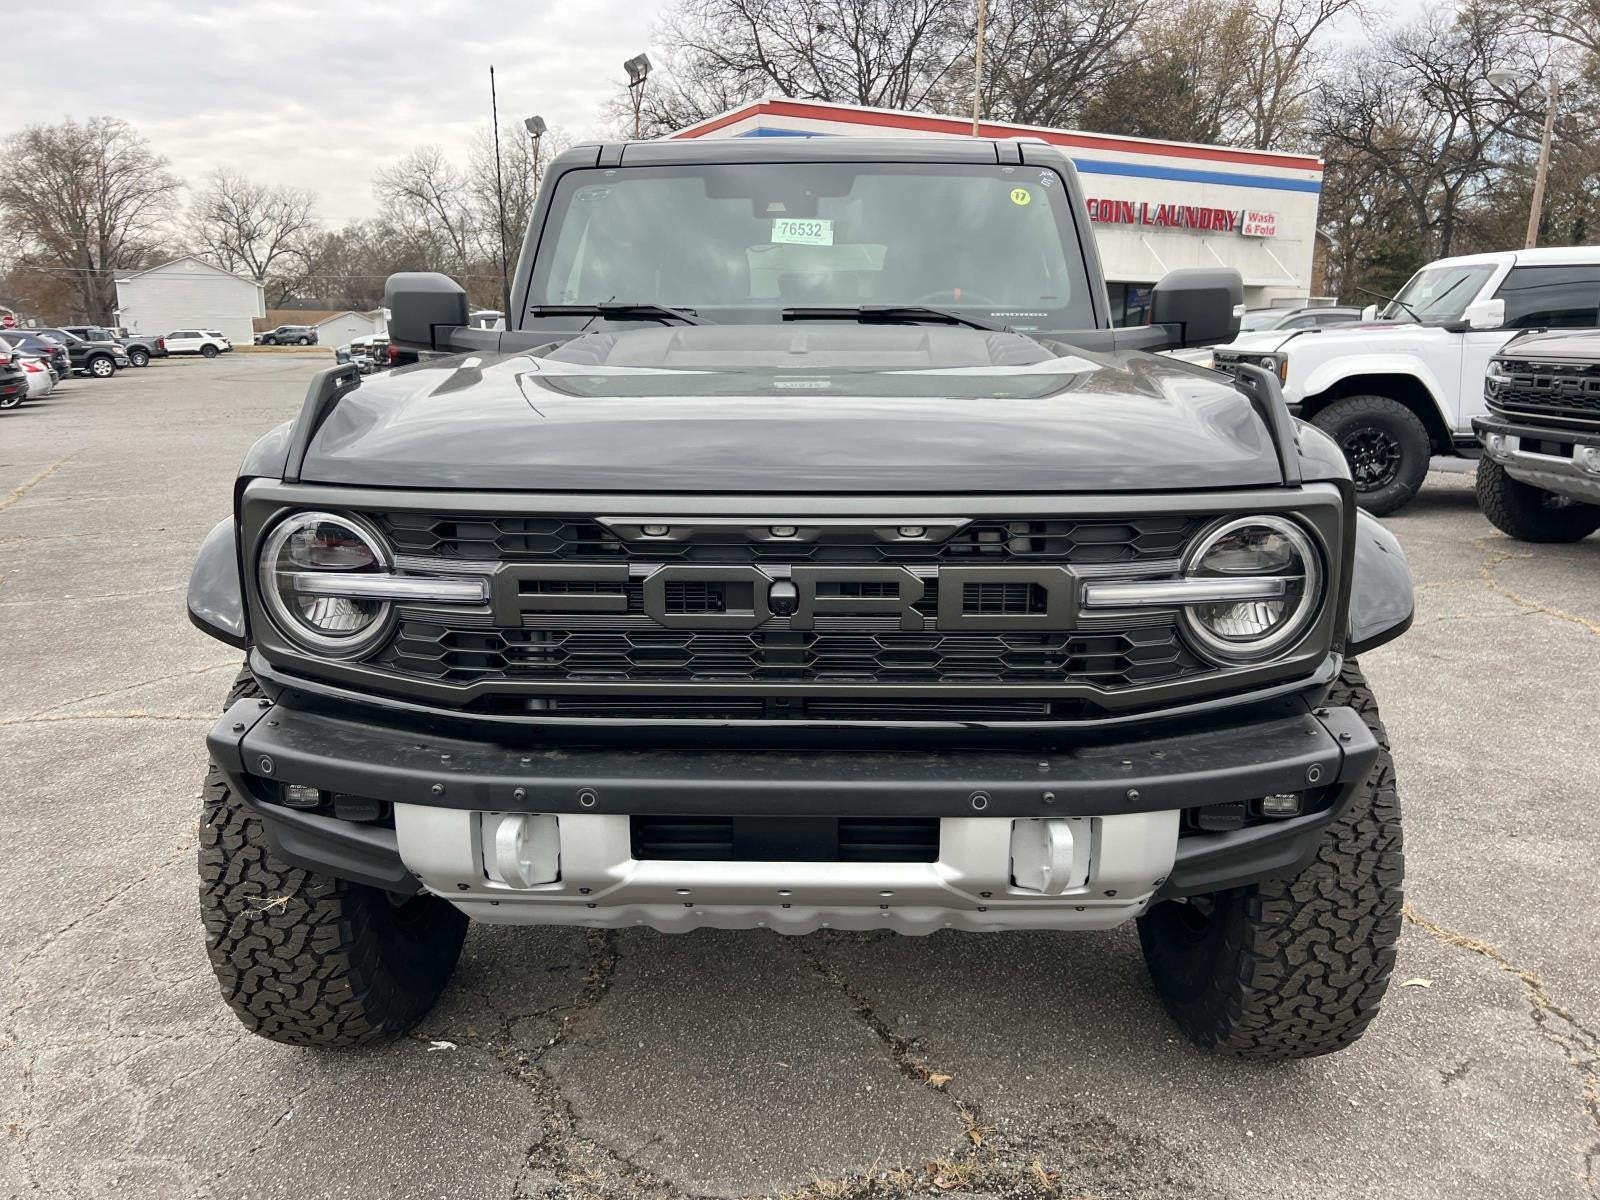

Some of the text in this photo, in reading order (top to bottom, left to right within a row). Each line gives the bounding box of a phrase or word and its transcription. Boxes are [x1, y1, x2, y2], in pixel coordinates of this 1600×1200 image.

[1087, 198, 1238, 232] COIN LAUNDRY
[1248, 212, 1275, 223] Wash
[781, 222, 822, 237] 76532
[1245, 225, 1275, 235] & Fold
[496, 565, 1077, 630] FORD
